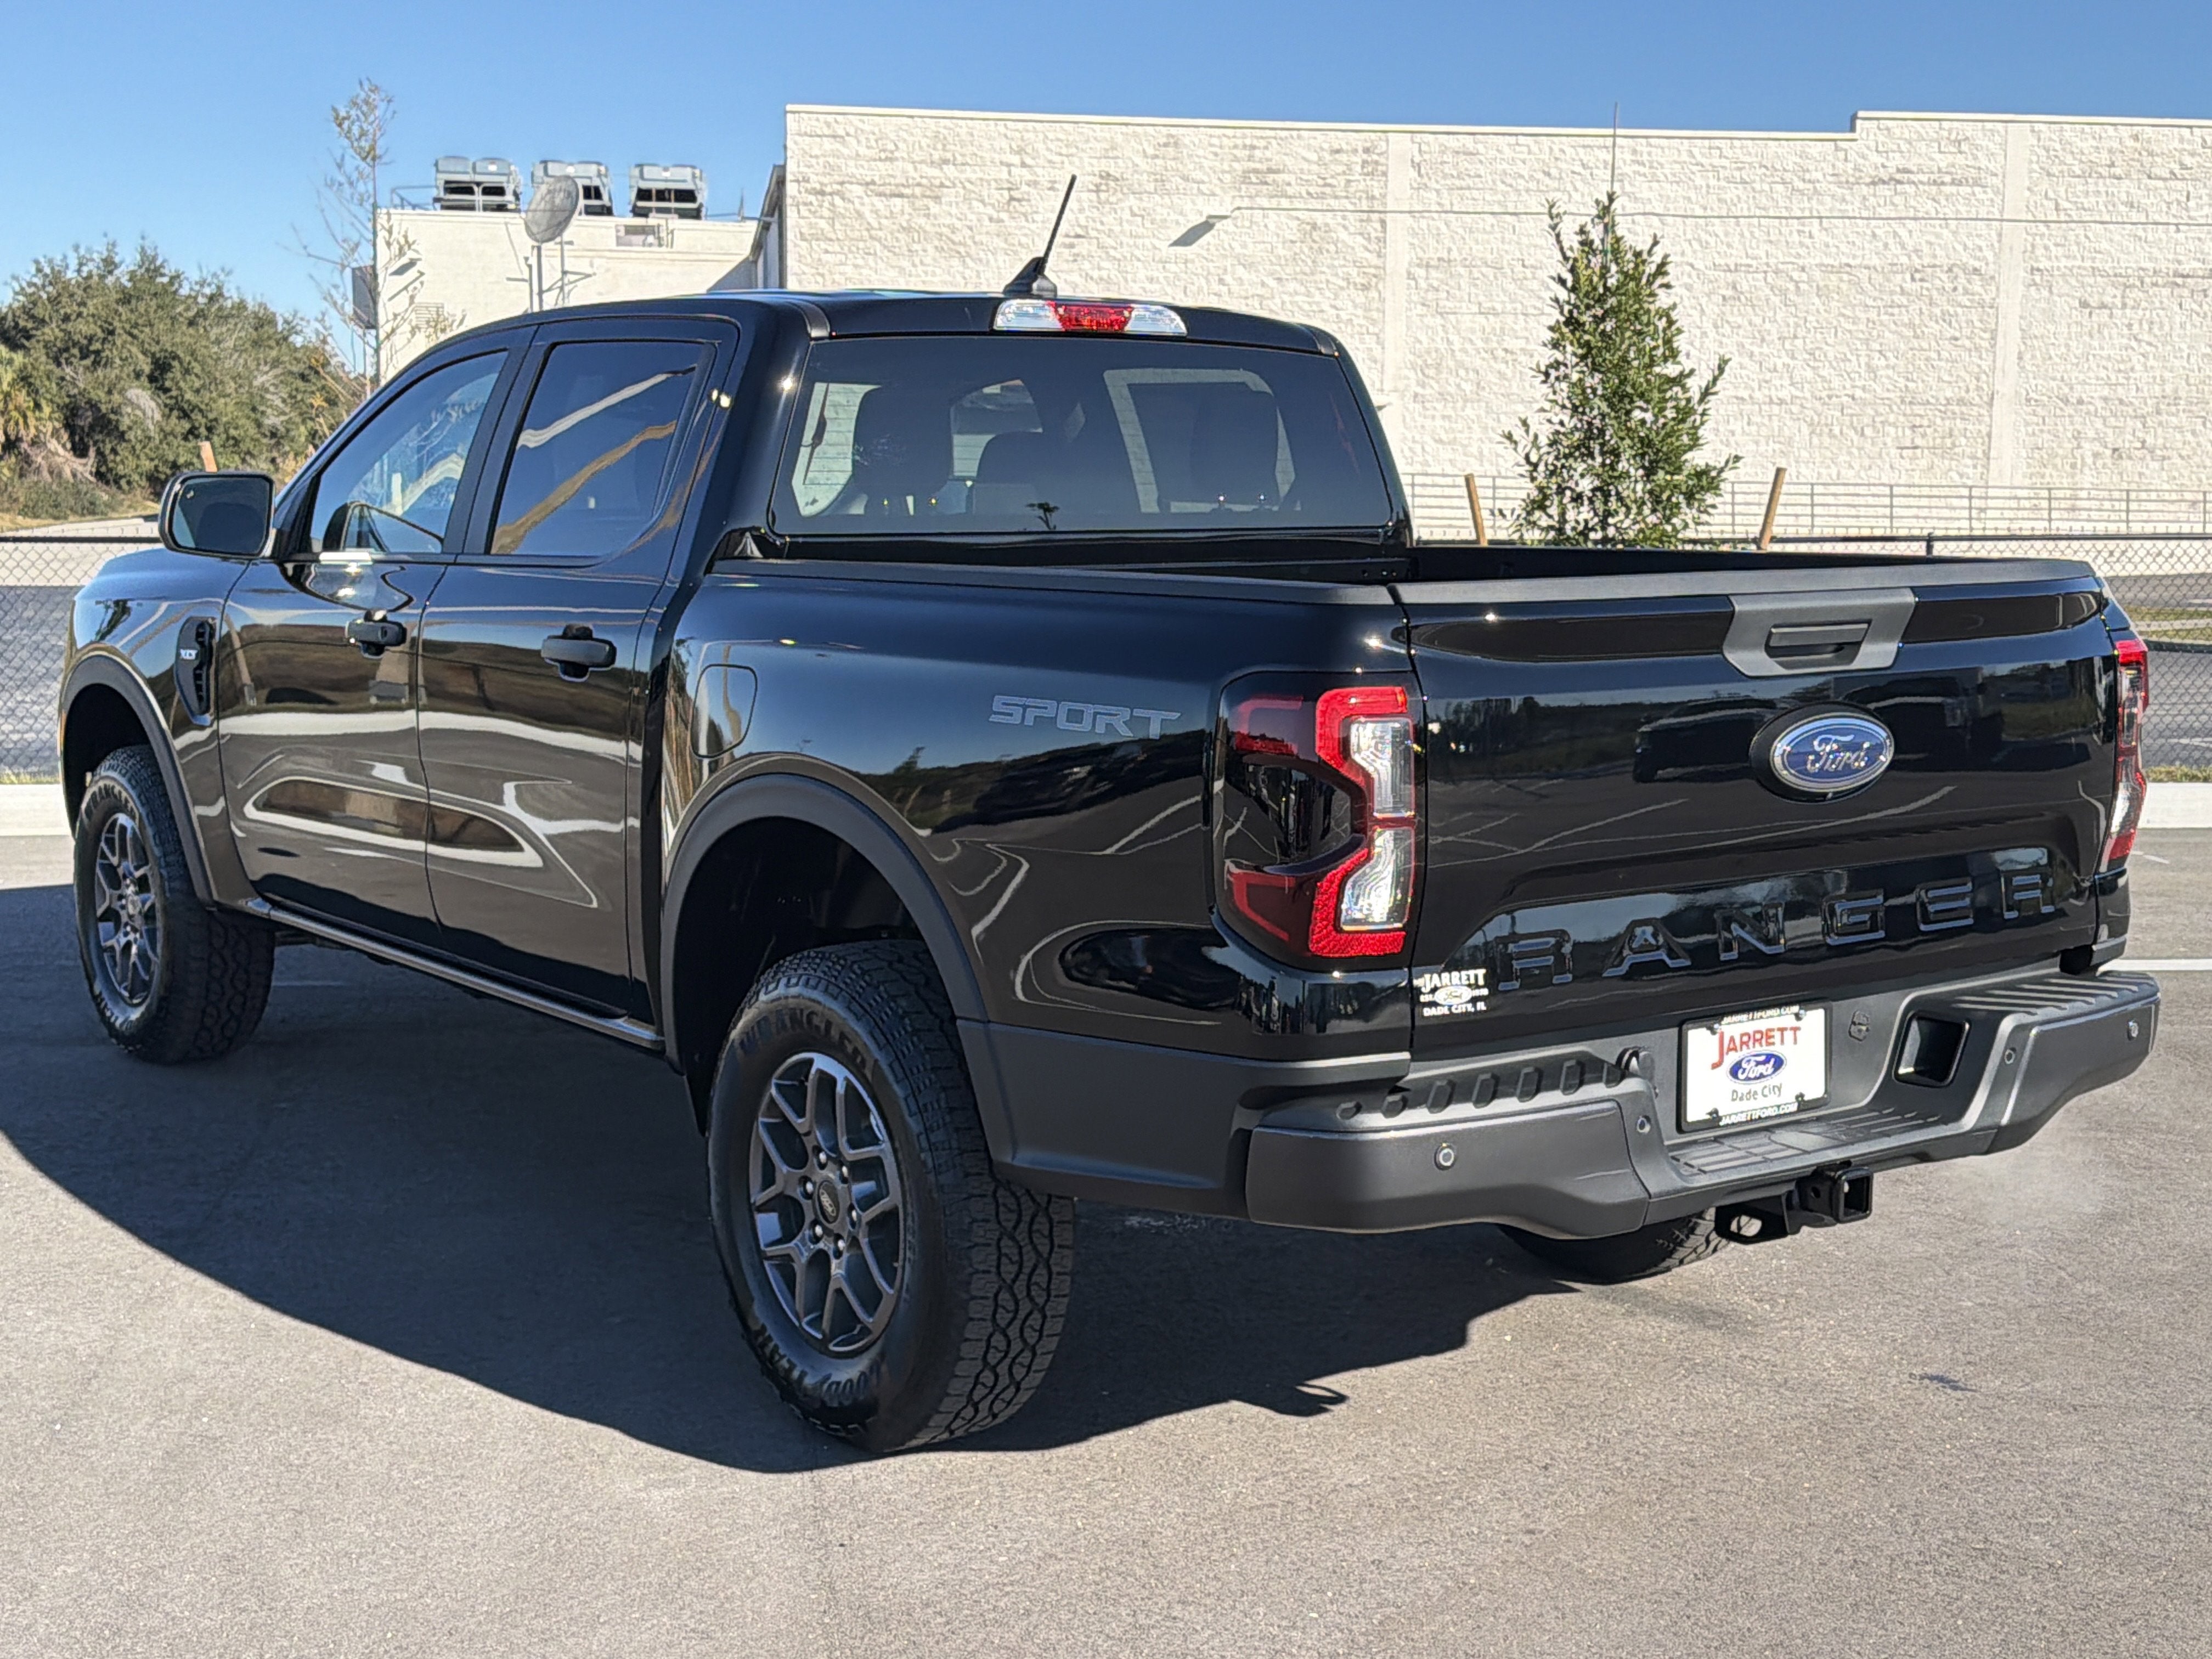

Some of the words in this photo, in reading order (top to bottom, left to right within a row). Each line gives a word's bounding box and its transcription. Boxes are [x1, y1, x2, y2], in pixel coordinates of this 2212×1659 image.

[989, 695, 1181, 740] SPORT
[1807, 734, 1870, 772] Ford
[1493, 867, 2056, 991] RANGER
[1420, 968, 1487, 993] JARRETT
[737, 1007, 868, 1068] WRANGLER
[1711, 1026, 1801, 1070] JARRETT
[1737, 1056, 1775, 1080] Ford
[1731, 1088, 1758, 1102] Dade
[1761, 1082, 1782, 1098] City
[1719, 1102, 1798, 1126] JARRETTFORD.COM
